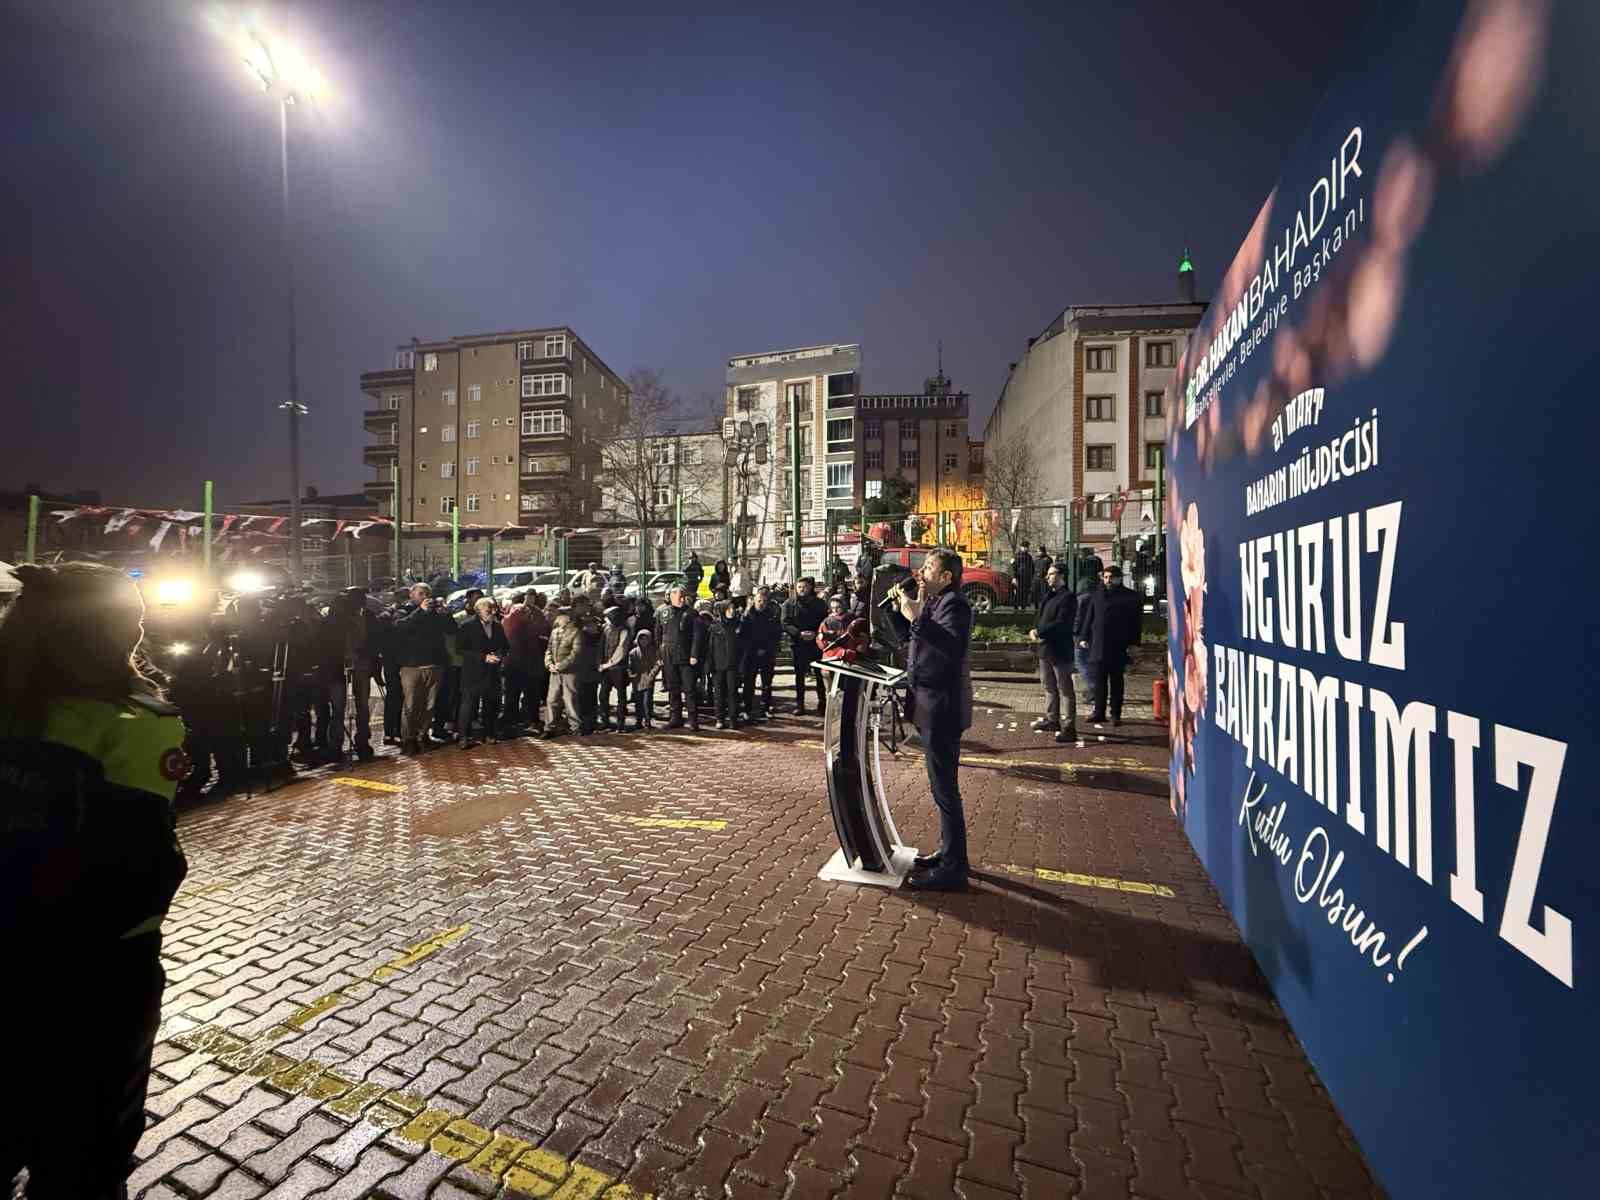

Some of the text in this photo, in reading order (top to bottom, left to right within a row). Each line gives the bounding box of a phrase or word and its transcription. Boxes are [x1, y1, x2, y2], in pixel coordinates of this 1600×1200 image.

[1240, 294, 1288, 364] Belediye
[1293, 198, 1364, 300] Başkanı
[1246, 407, 1379, 517] BAHARIN MÜJDECİSİ
[1272, 387, 1325, 452] 21 MART
[1239, 501, 1406, 671] NEVRUZ
[1213, 643, 1574, 989] BAYRAMIMIZ
[1238, 771, 1428, 984] Kutlu Olsun!
